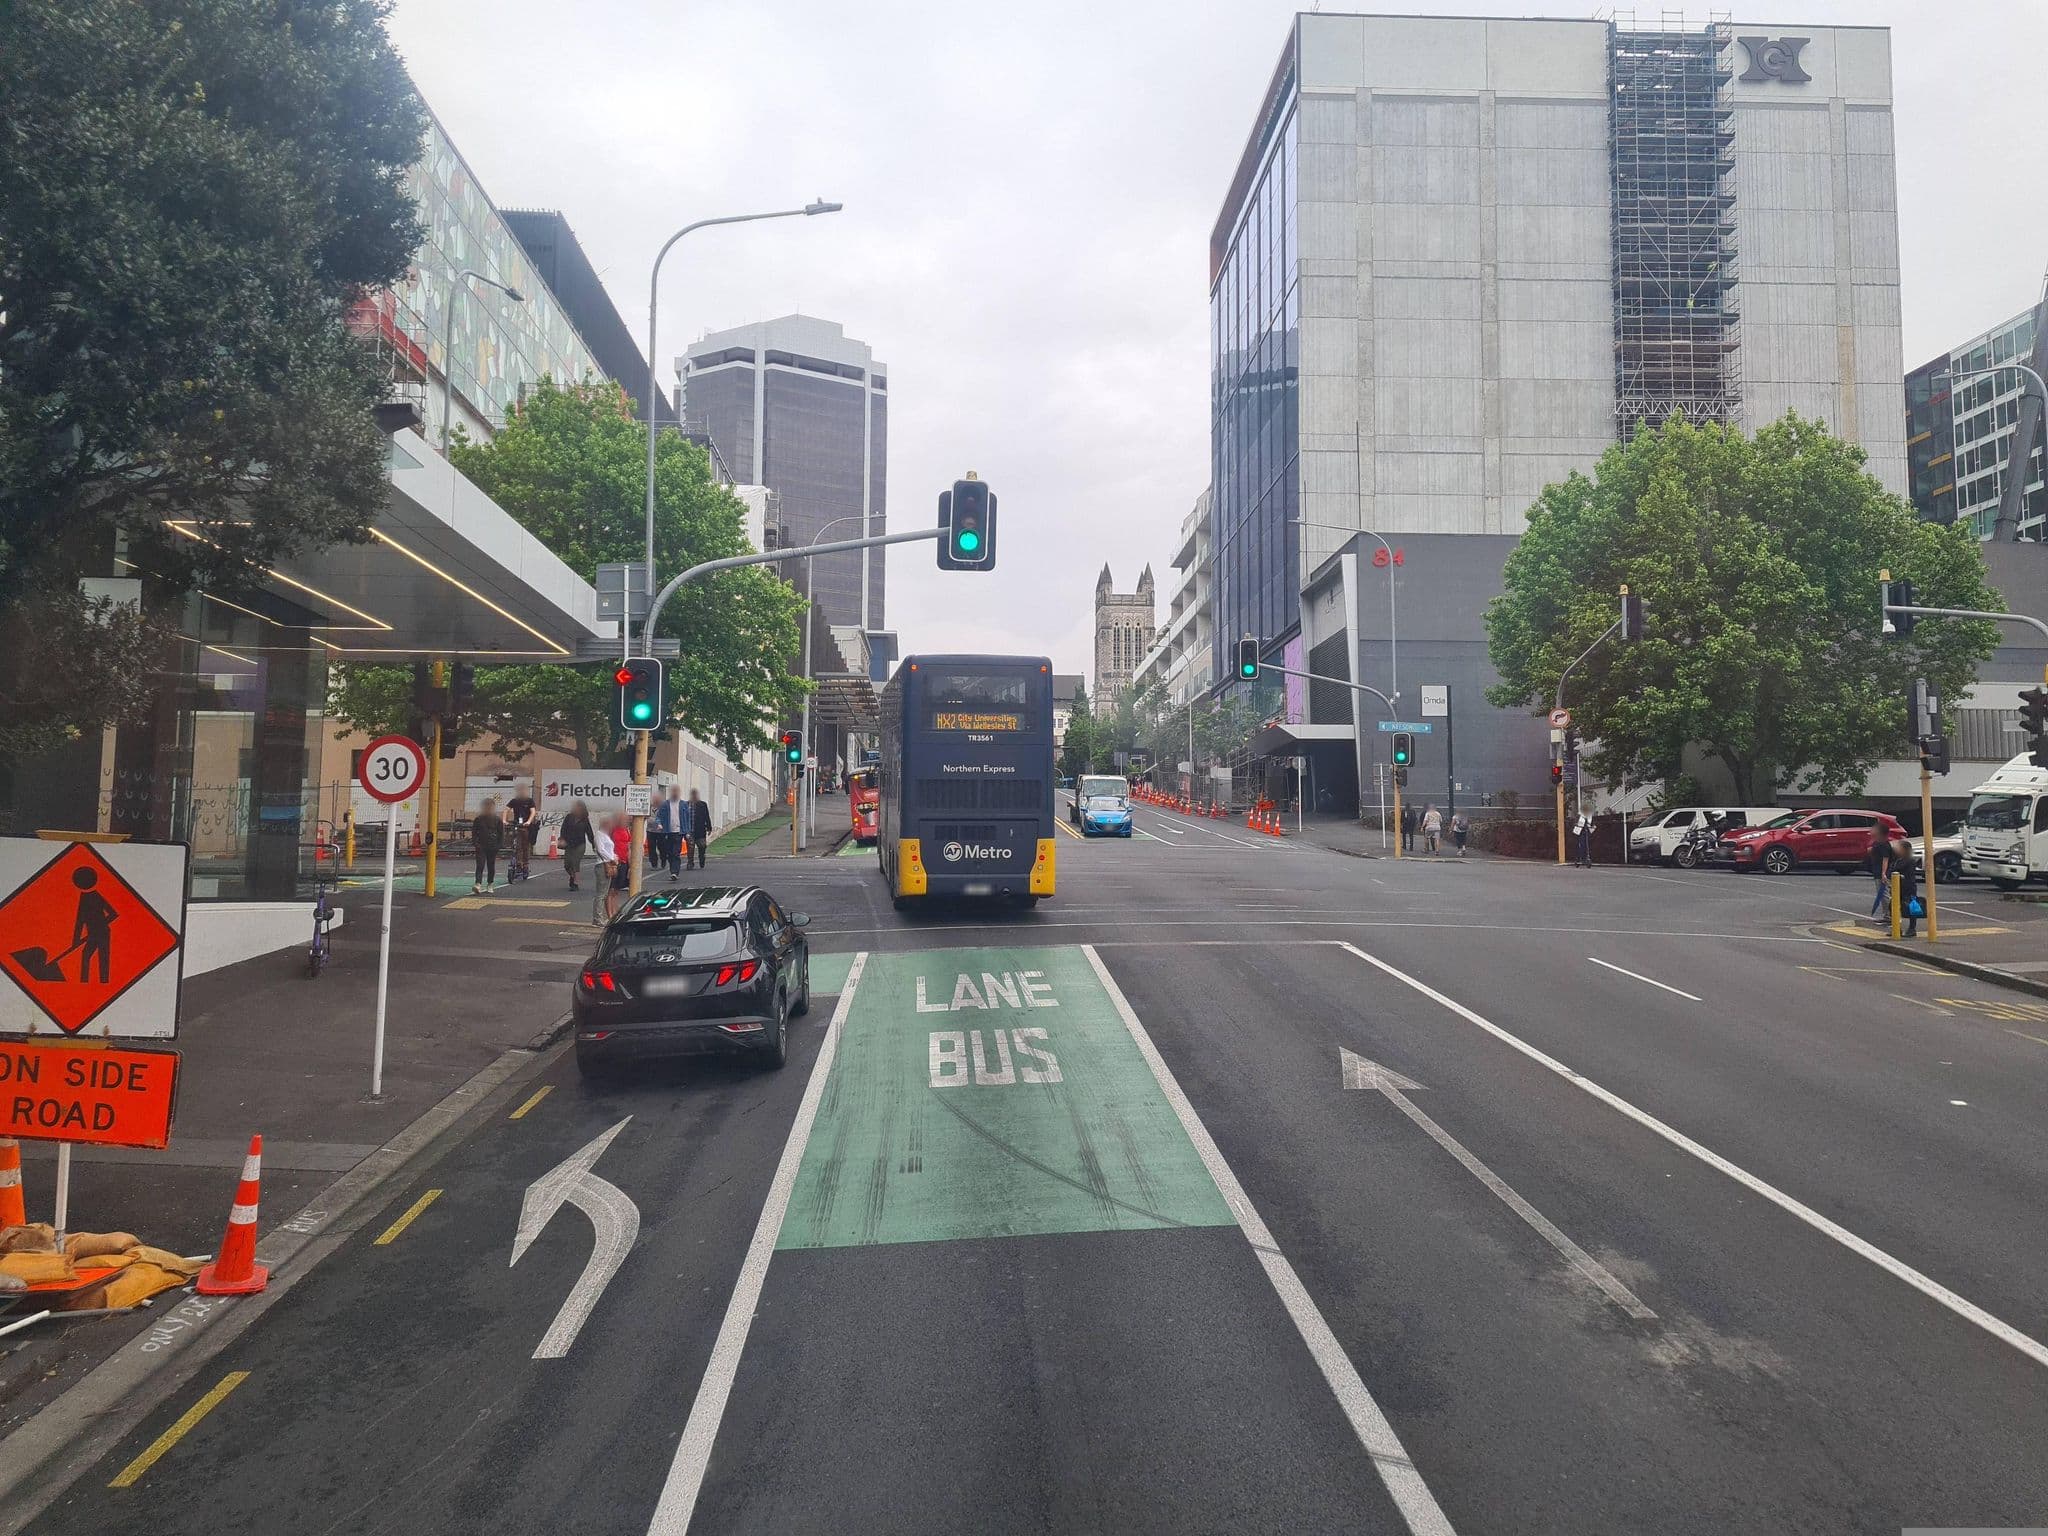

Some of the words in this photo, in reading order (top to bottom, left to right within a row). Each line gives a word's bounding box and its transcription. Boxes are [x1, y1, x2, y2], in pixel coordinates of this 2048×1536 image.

[1372, 547, 1405, 567] 84
[958, 713, 972, 722] City
[968, 734, 993, 742] TR3561
[375, 757, 409, 780] 30
[943, 764, 981, 773] Northern
[983, 764, 1016, 775] Express
[561, 783, 626, 797] Fletcher
[964, 844, 1012, 859] Metro
[916, 968, 1060, 1013] LANE
[929, 1027, 1064, 1088] BUS
[64, 1058, 148, 1091] SIDE
[11, 1096, 116, 1131] ROAD
[141, 1316, 192, 1351] ONLY
